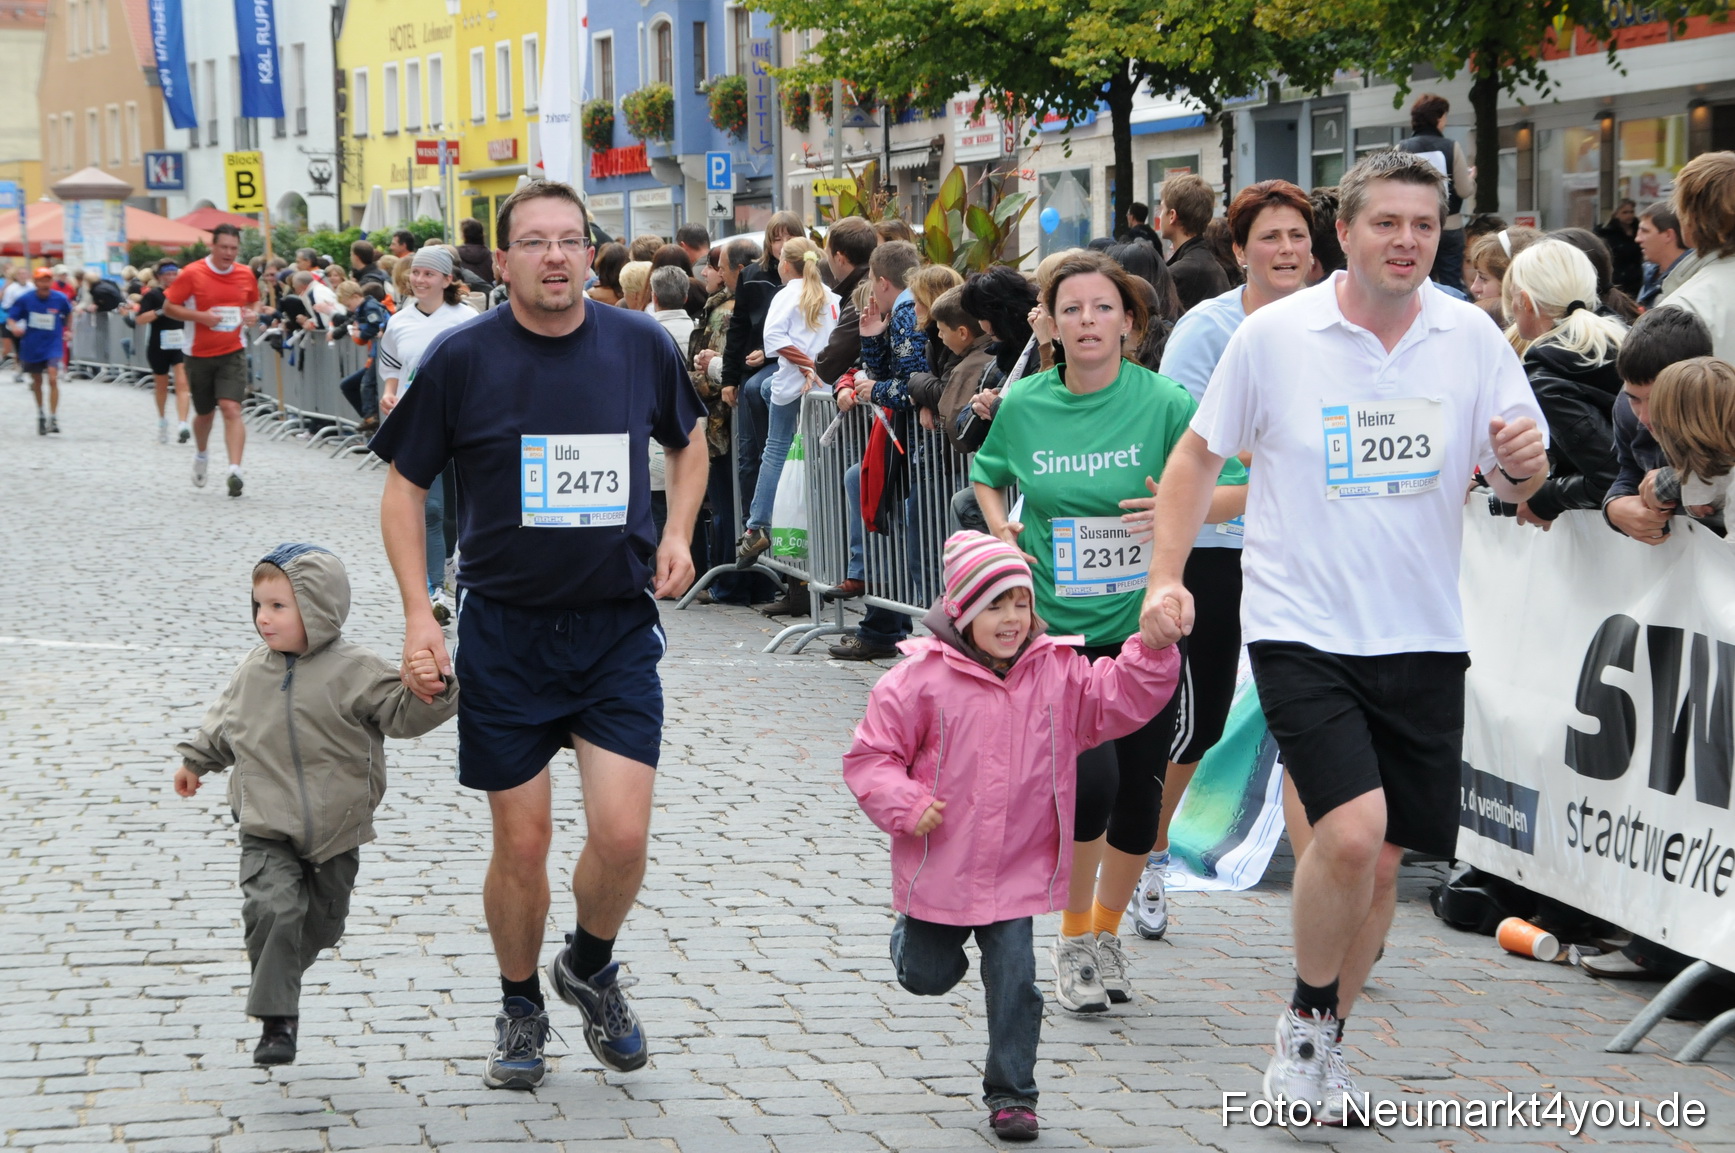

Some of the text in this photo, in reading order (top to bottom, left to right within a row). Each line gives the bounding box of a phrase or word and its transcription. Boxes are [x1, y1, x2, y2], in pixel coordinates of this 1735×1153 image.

[389, 24, 417, 53] HOTEL
[258, 47, 274, 84] K&L
[227, 155, 260, 166] Block
[711, 157, 727, 187] P
[236, 171, 256, 199] B
[1357, 410, 1396, 428] Heinz
[555, 444, 580, 461] Udo
[1333, 439, 1341, 453] C
[1361, 433, 1432, 463] 2023
[530, 470, 537, 482] C
[556, 470, 620, 495] 2473
[591, 511, 626, 521] PFLEIDERER
[1082, 545, 1142, 569] 2312
[1477, 795, 1529, 834] verbinden
[1566, 796, 1735, 898] stadtwerke
